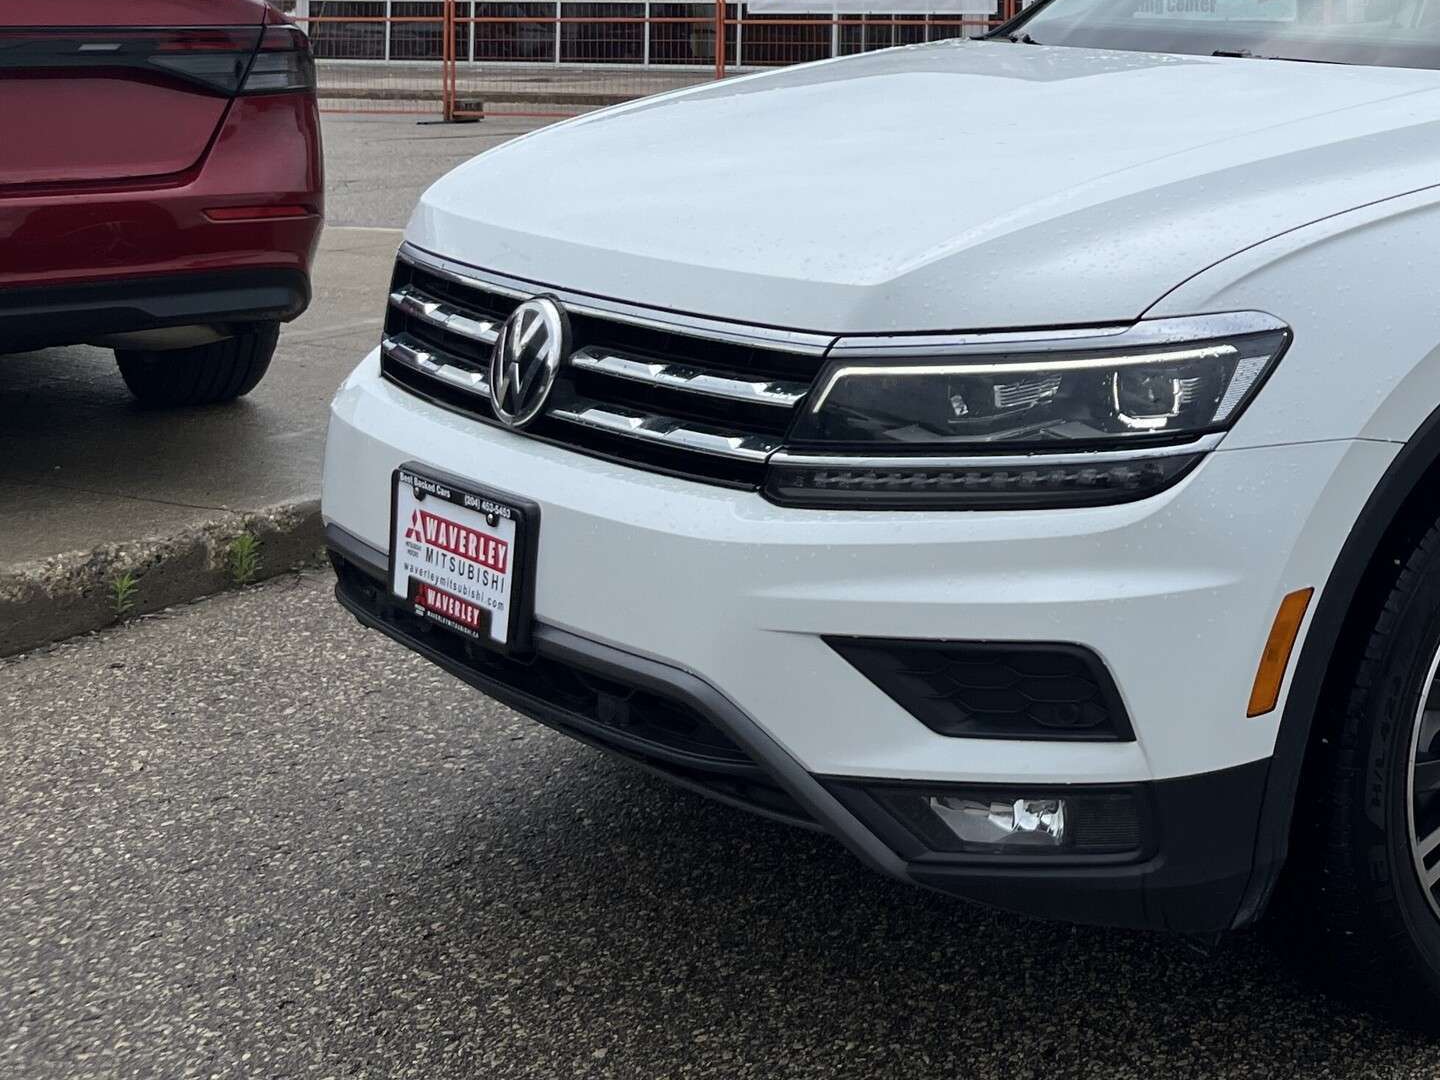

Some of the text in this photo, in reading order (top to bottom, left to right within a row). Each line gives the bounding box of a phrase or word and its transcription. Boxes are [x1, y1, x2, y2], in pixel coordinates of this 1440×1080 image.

[436, 485, 451, 498] Cars
[425, 515, 508, 571] WAVERLEY
[403, 562, 505, 611] waverleymitsubishi.com
[425, 546, 505, 594] MITSUBISHI
[426, 588, 480, 625] WAVERLEY
